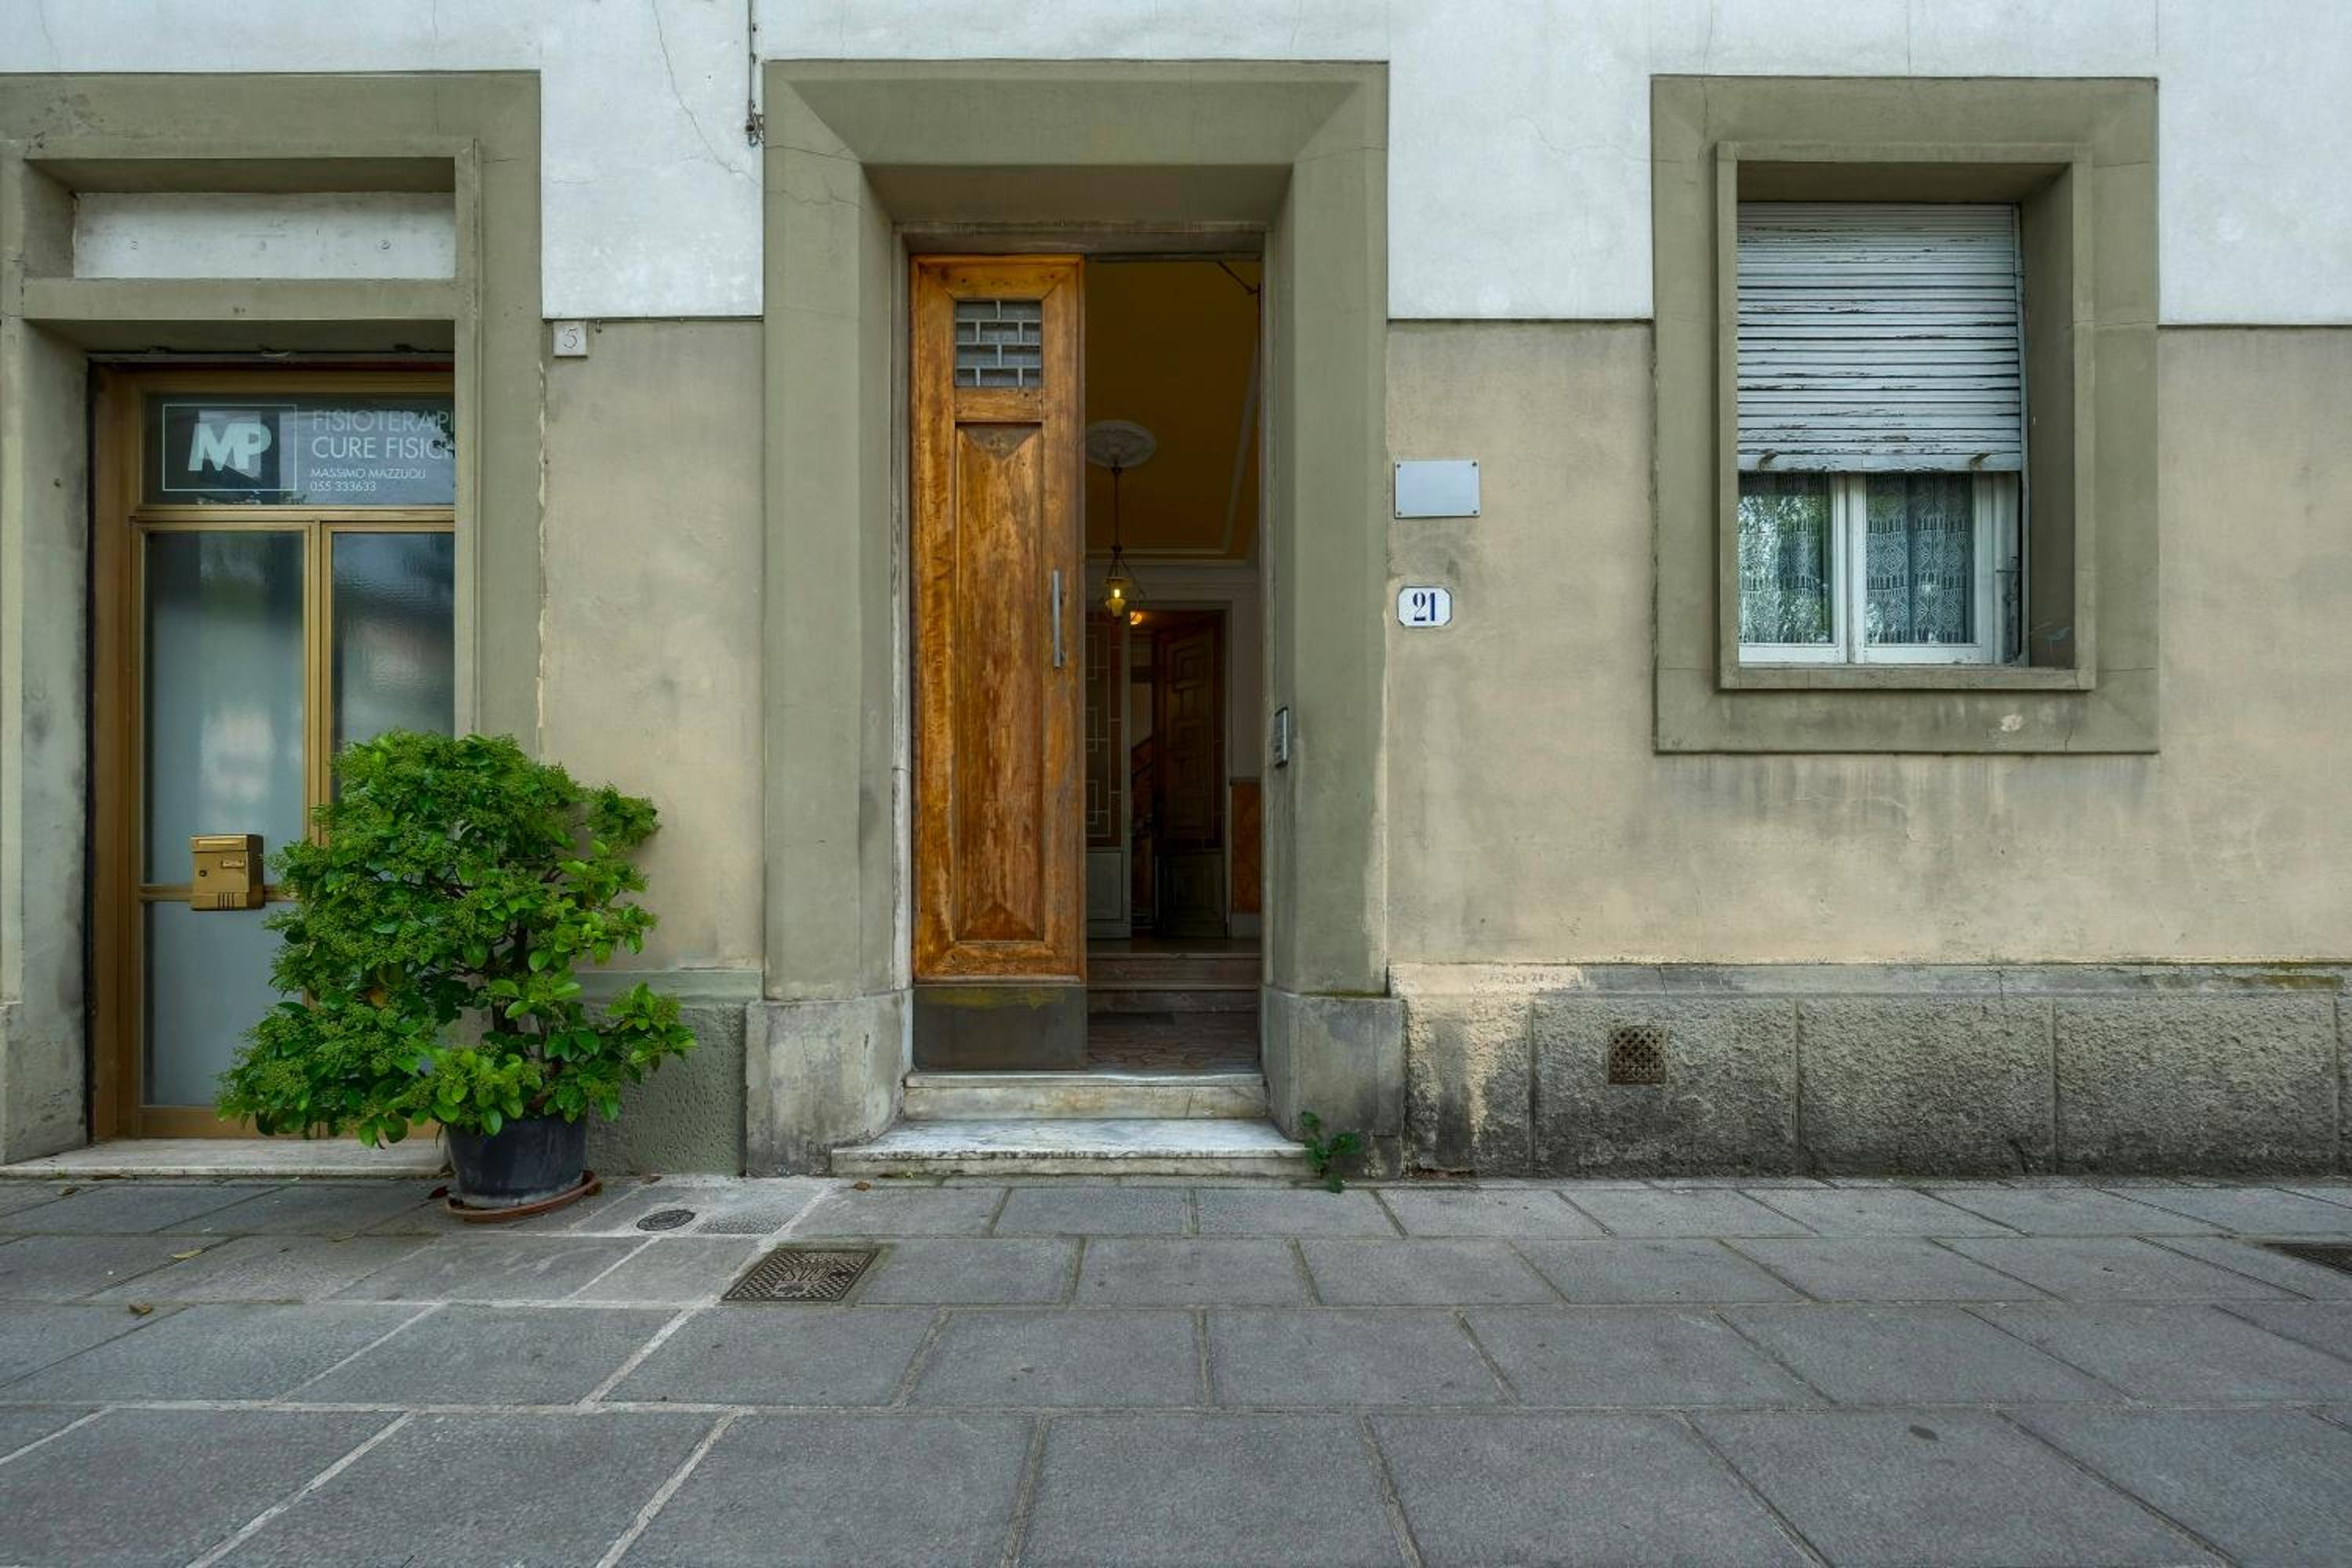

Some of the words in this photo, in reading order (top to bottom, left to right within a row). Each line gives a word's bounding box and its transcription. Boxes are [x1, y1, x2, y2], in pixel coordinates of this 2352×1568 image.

[187, 423, 272, 471] MP
[311, 436, 376, 459] CURE
[310, 468, 365, 479] MASSIMO
[310, 481, 331, 492] 055
[1413, 592, 1436, 622] 21
